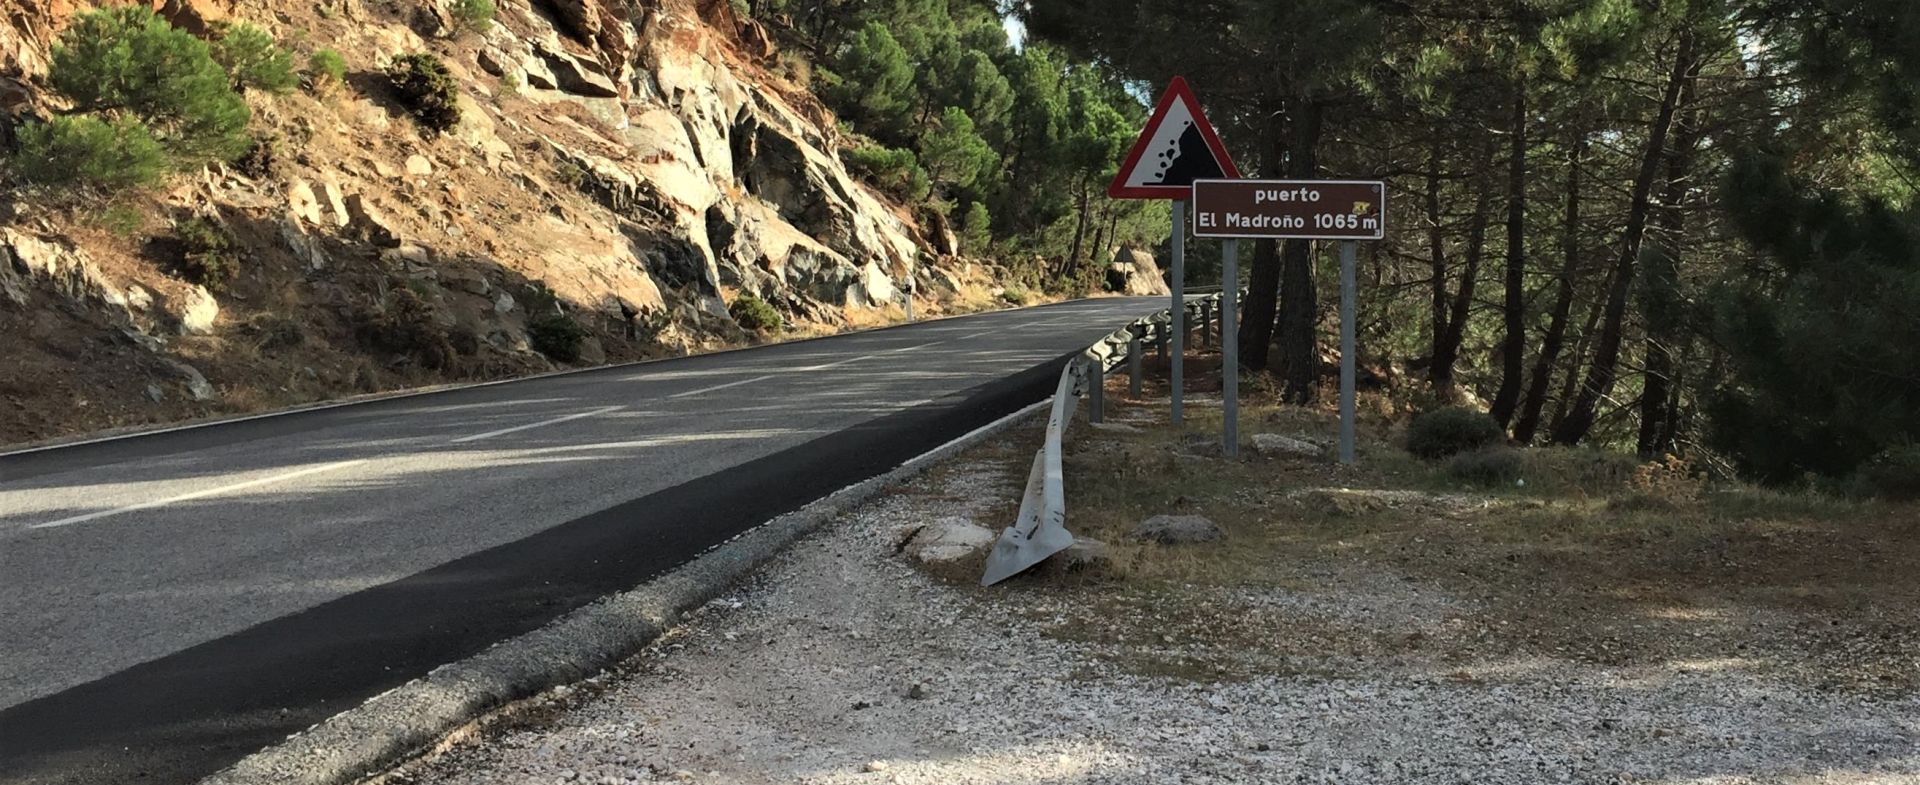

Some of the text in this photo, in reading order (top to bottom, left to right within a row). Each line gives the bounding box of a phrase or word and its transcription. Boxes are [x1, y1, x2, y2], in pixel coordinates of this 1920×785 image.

[1255, 187, 1320, 204] puerto
[1199, 212, 1377, 230] El Madroño 1065 m
